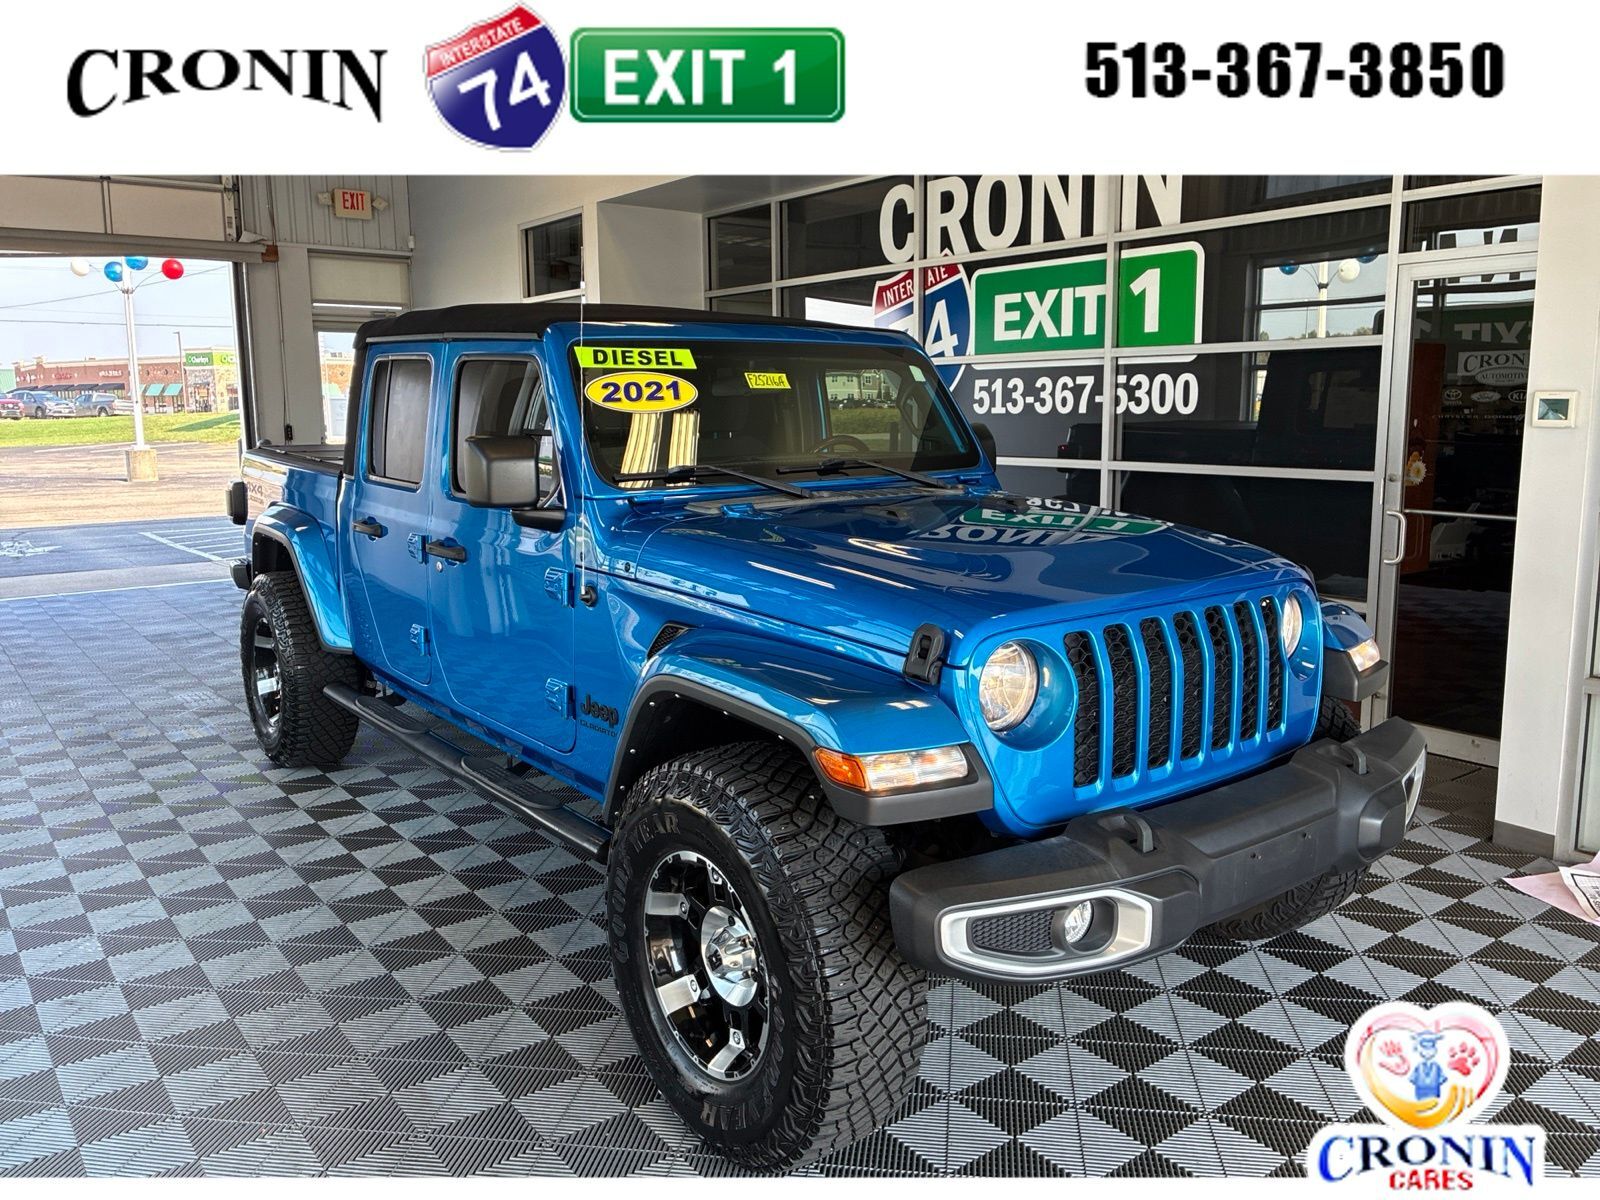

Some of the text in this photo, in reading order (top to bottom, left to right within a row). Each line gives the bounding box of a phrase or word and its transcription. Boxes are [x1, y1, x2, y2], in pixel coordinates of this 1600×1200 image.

[342, 191, 365, 211] EXIT
[879, 174, 1183, 264] CRONIN
[882, 263, 949, 308] INTERATE
[994, 268, 1161, 342] EXIT 1
[592, 349, 683, 366] DIESEL
[601, 380, 682, 403] 2021
[972, 373, 1199, 415] 513-367-5300
[580, 693, 620, 729] Jeep
